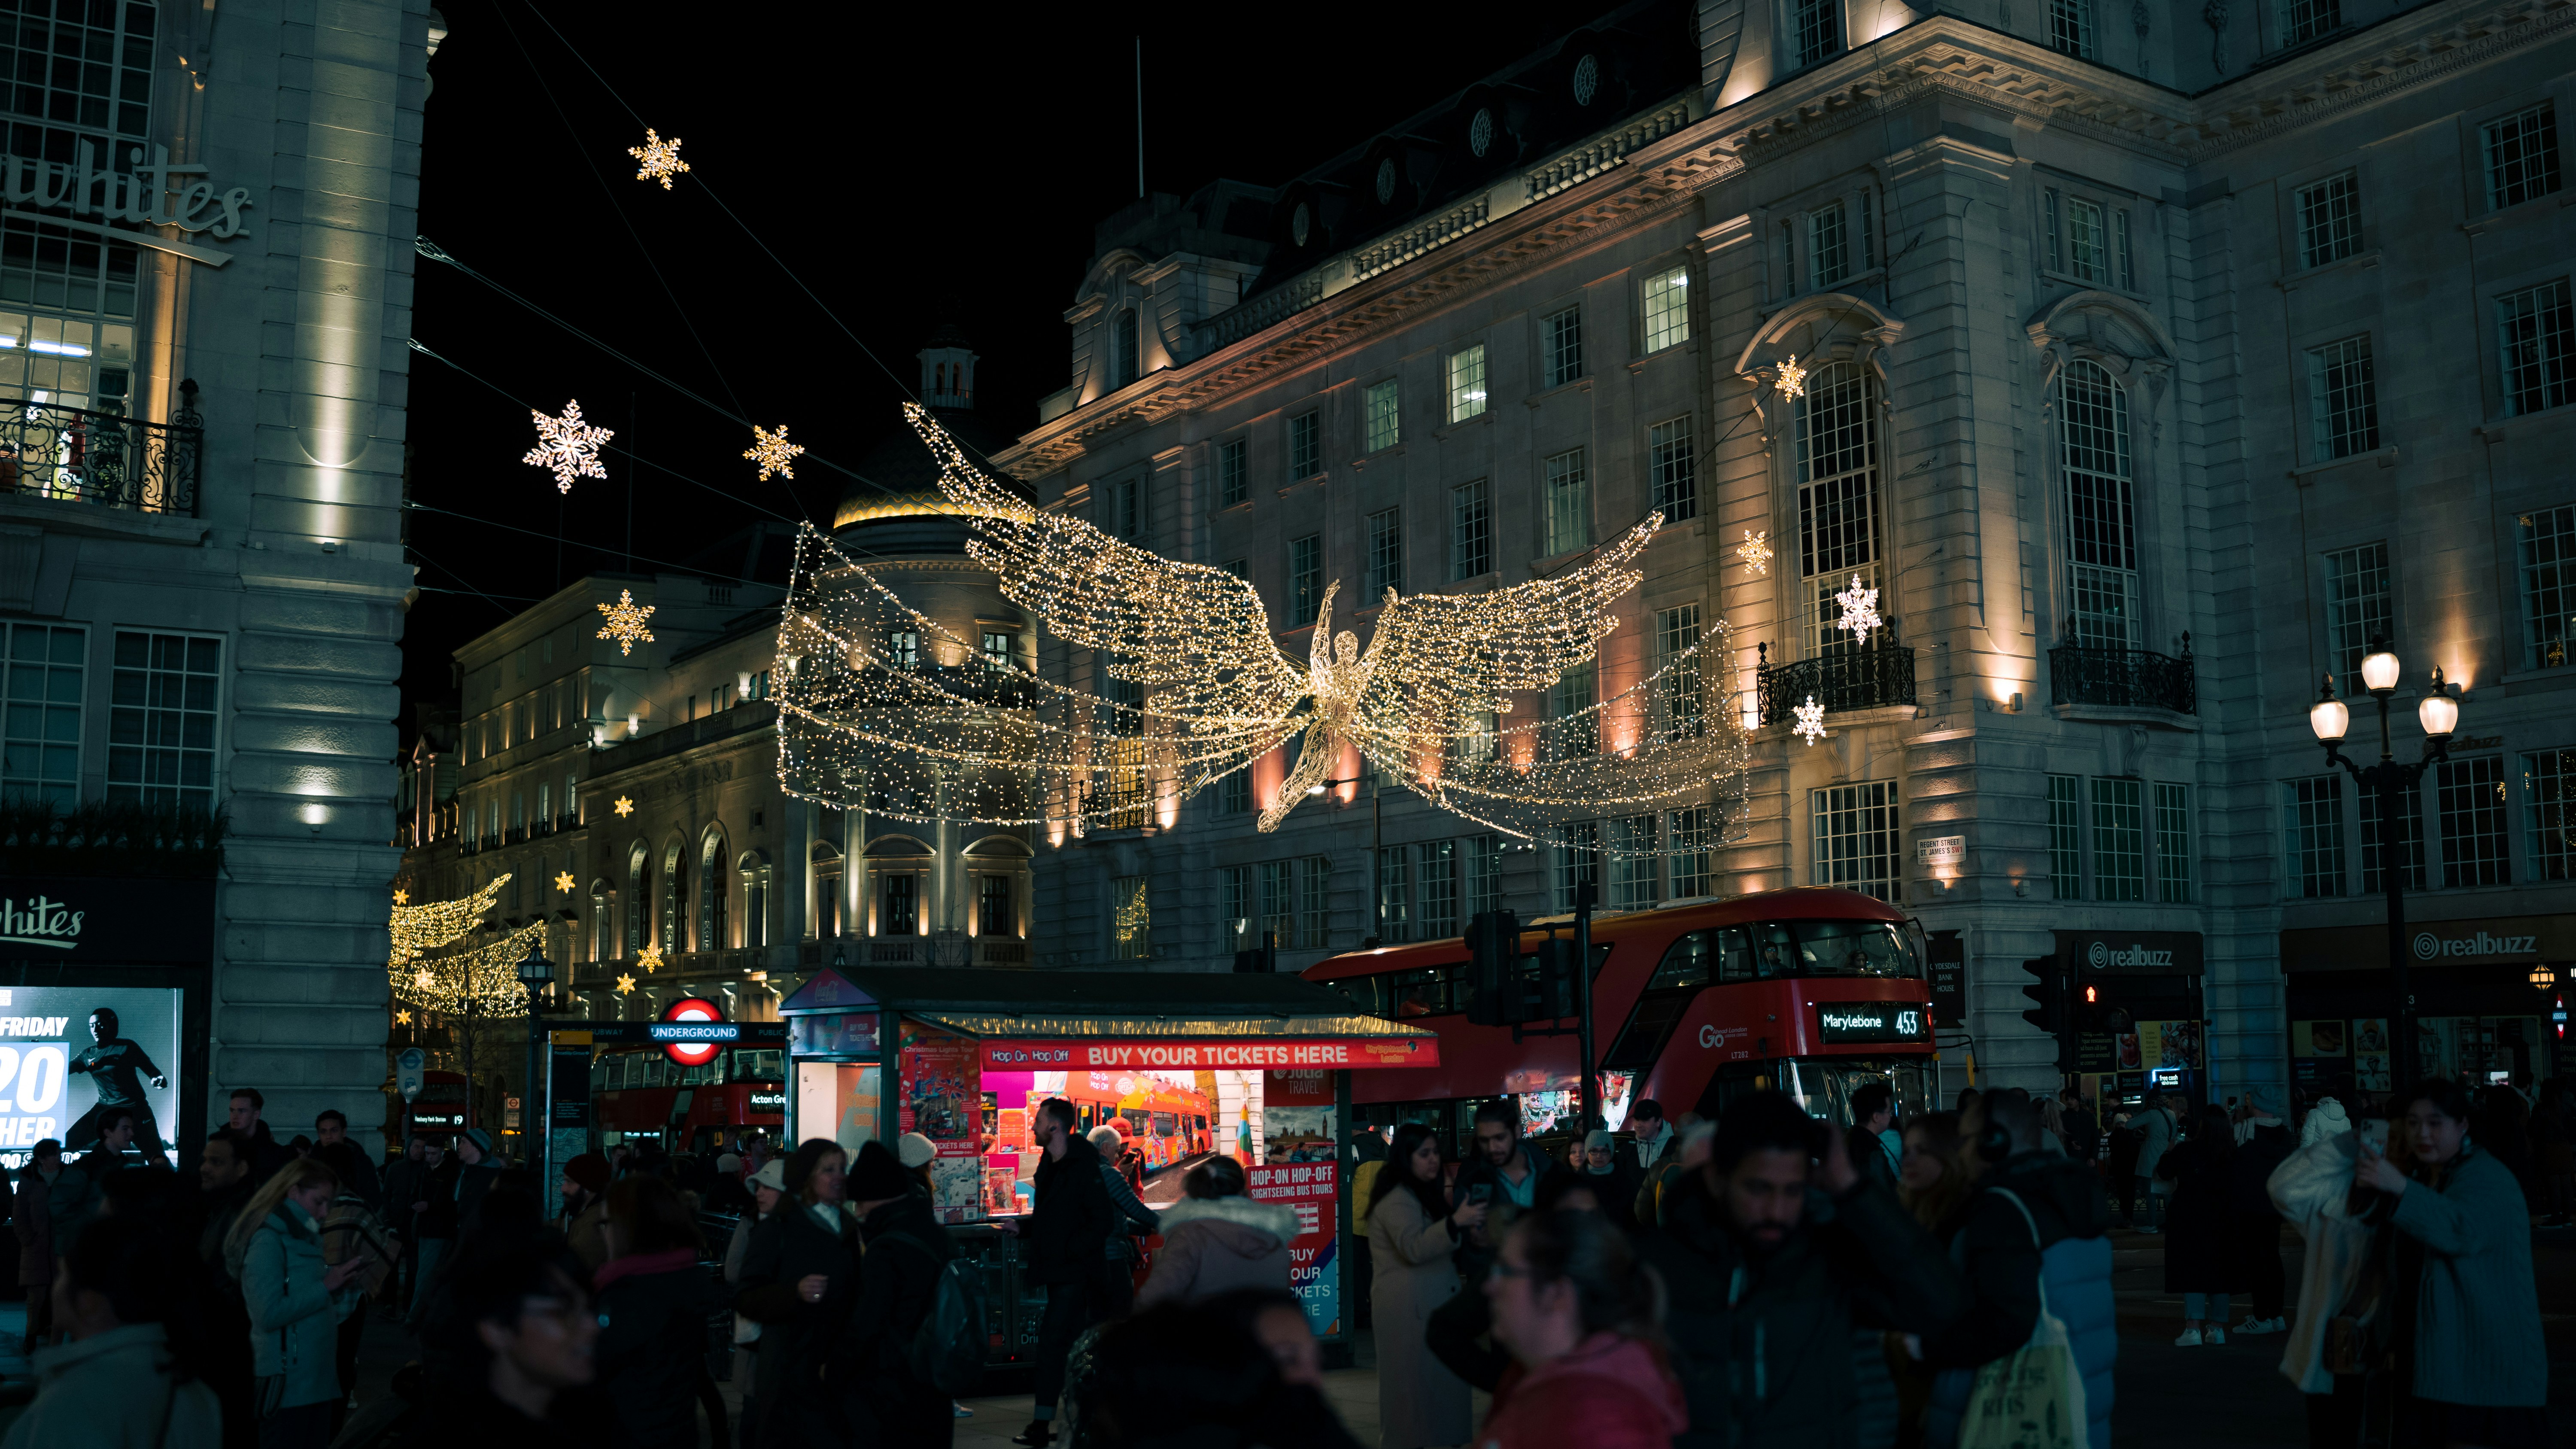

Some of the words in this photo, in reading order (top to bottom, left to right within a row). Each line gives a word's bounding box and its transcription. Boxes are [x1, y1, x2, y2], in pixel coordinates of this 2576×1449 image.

[1, 138, 250, 238] whites
[2446, 735, 2503, 752] ealbuzz
[1929, 848, 1950, 856] JAMES'S
[0, 895, 85, 936] hites
[2442, 932, 2537, 956] realbuzz
[2109, 945, 2172, 966] realbuzz
[2408, 995, 2415, 1004] 3
[0, 1017, 69, 1036] FRIDAY
[1823, 1014, 1881, 1030] Marylebone
[1896, 1011, 1917, 1034] 453
[651, 1028, 737, 1037] UNDERGROUND
[1699, 1024, 1724, 1048] Go
[992, 1050, 1012, 1063] Hop
[1014, 1049, 1028, 1061] On
[1032, 1050, 1051, 1063] Hop
[1054, 1049, 1069, 1061] Off
[1088, 1047, 1132, 1065] BUY
[1137, 1047, 1197, 1065] YOUR
[1203, 1047, 1288, 1064] TICKETS
[1294, 1046, 1348, 1063] HERE
[2560, 1054, 2576, 1063] sho
[1288, 1080, 1319, 1094] TRAVEL
[751, 1095, 772, 1103] Acton
[454, 1115, 463, 1124] 19
[1251, 1168, 1288, 1186] HOP-ON
[1291, 1166, 1333, 1183] HOP-OFF
[1252, 1186, 1295, 1199] SIGHTSEEING
[1297, 1185, 1309, 1195] BUS
[1312, 1183, 1333, 1195] TOURS
[1290, 1267, 1321, 1280] OUR
